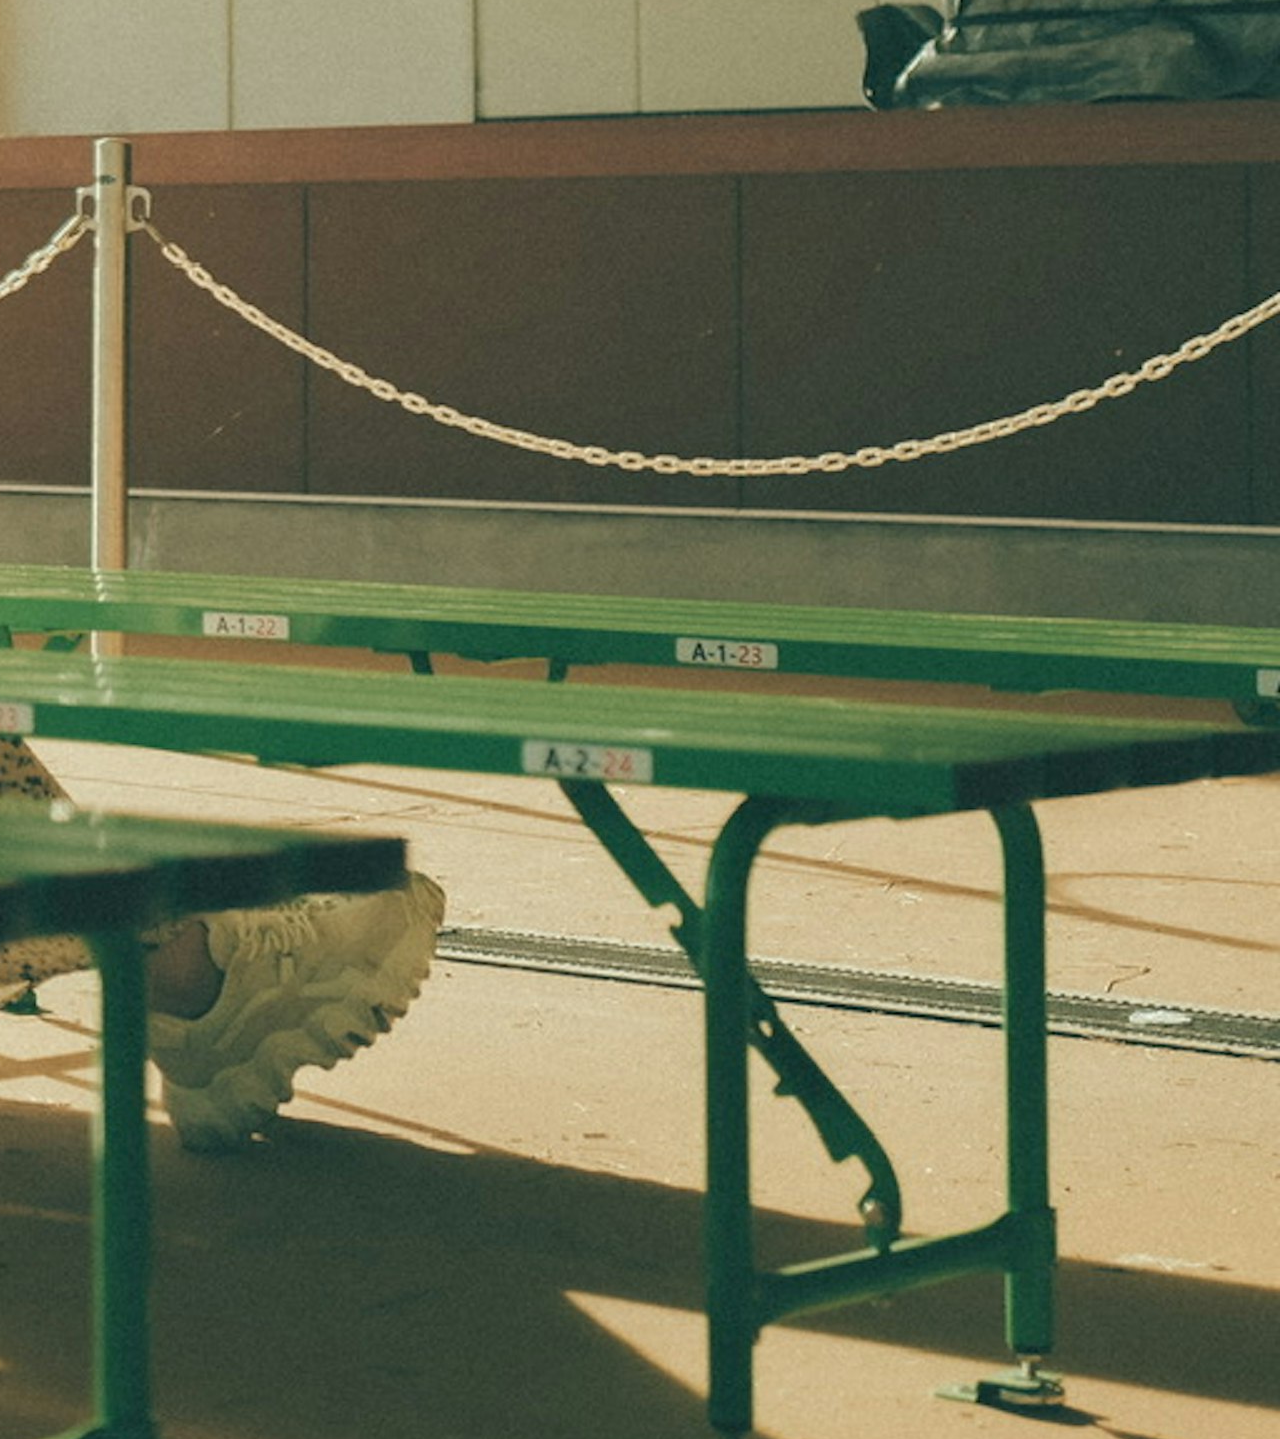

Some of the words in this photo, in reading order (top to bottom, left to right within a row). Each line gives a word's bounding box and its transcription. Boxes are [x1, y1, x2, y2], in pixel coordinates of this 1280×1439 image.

[216, 616, 276, 636] A-1-22
[692, 641, 763, 665] A-1-23
[543, 747, 634, 780] A-2-24
